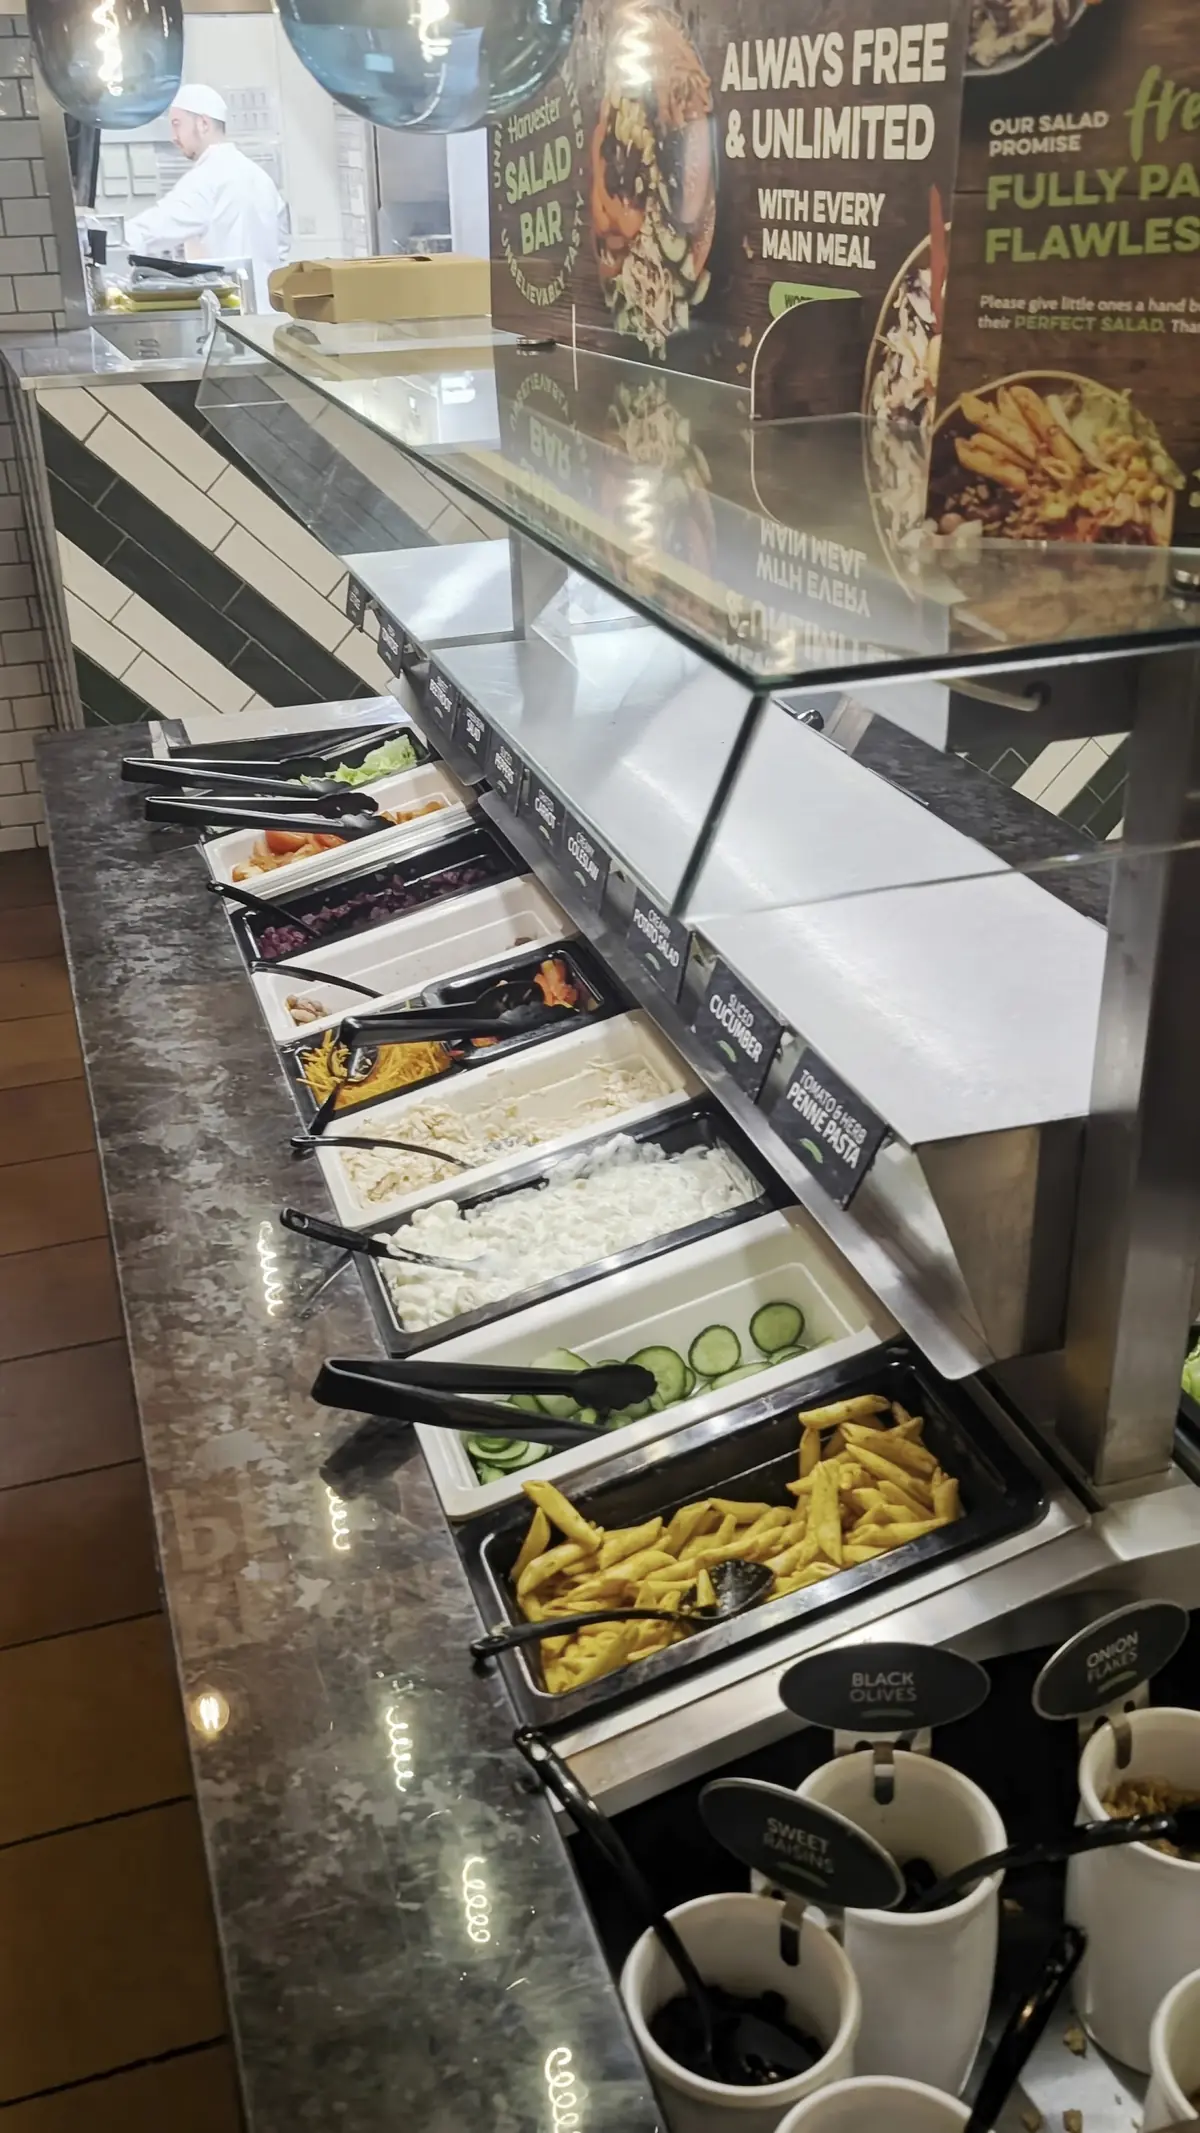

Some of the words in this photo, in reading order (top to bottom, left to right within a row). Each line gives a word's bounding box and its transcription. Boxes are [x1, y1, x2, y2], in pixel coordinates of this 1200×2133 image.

[720, 32, 845, 92] ALWAYS
[852, 22, 949, 86] FREE
[508, 96, 561, 144] Harvester
[725, 109, 746, 159] &
[752, 104, 935, 161] UNLIMITED
[990, 118, 1034, 136] OUR
[1039, 111, 1110, 133] SALAD
[989, 134, 1082, 157] PROMISE
[505, 136, 572, 204] SALAD
[987, 166, 1129, 211] FULLY
[1139, 162, 1200, 201] PA
[520, 200, 563, 255] BAR
[758, 188, 809, 221] WITH
[812, 190, 886, 227] EVERY
[762, 228, 812, 263] MAIN
[816, 233, 877, 270] MEAL
[985, 216, 1200, 264] FLAWLES
[978, 315, 1012, 330] their
[1015, 315, 1097, 332] PERFECT
[980, 294, 1026, 311] Please
[1029, 297, 1058, 314] give
[1062, 296, 1094, 311] little
[1098, 299, 1132, 312] ones
[1135, 301, 1145, 312] a
[1149, 297, 1185, 312] hand
[567, 836, 600, 881] COLESLAW
[633, 908, 659, 944] POTATO
[656, 934, 680, 968] SALAD
[709, 994, 763, 1063] CUCUMBER
[728, 993, 754, 1028] SLICED
[786, 1081, 829, 1133] PENNE
[822, 1119, 861, 1169] PASTA
[800, 1069, 837, 1113] TOMATO
[840, 1111, 868, 1145] HERB
[1086, 1631, 1138, 1668] ONION
[1087, 1648, 1138, 1684] FLAKES
[850, 1687, 917, 1703] OLIVES
[852, 1672, 914, 1688] BLACK
[763, 1832, 834, 1874] RAISINS
[767, 1817, 829, 1855] SWEET
